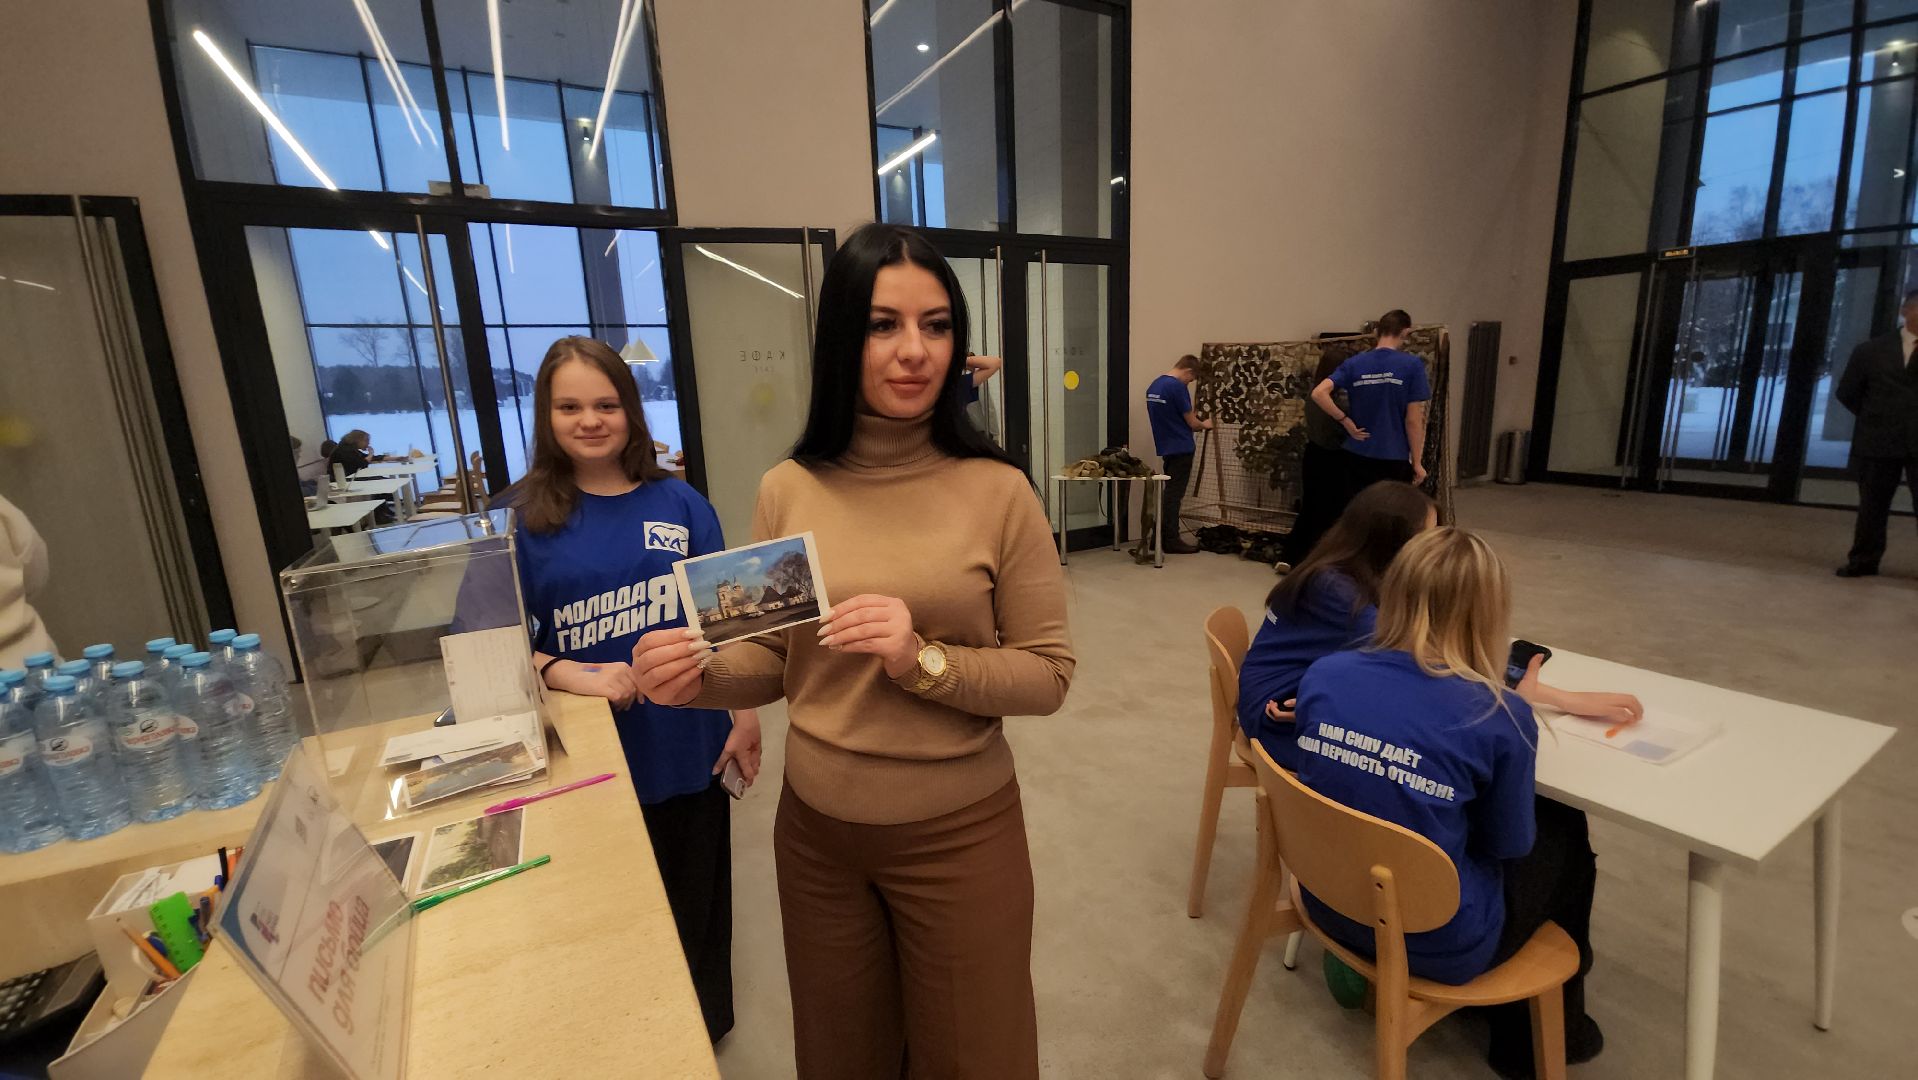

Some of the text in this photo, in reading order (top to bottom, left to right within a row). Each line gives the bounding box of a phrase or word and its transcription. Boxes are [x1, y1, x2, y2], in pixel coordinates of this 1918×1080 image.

[1297, 735, 1455, 801] АША ВЕРНОСТЬ ОТЧИЗНЕ
[1319, 722, 1422, 769] НАМ СИЛУ ДАЁТ
